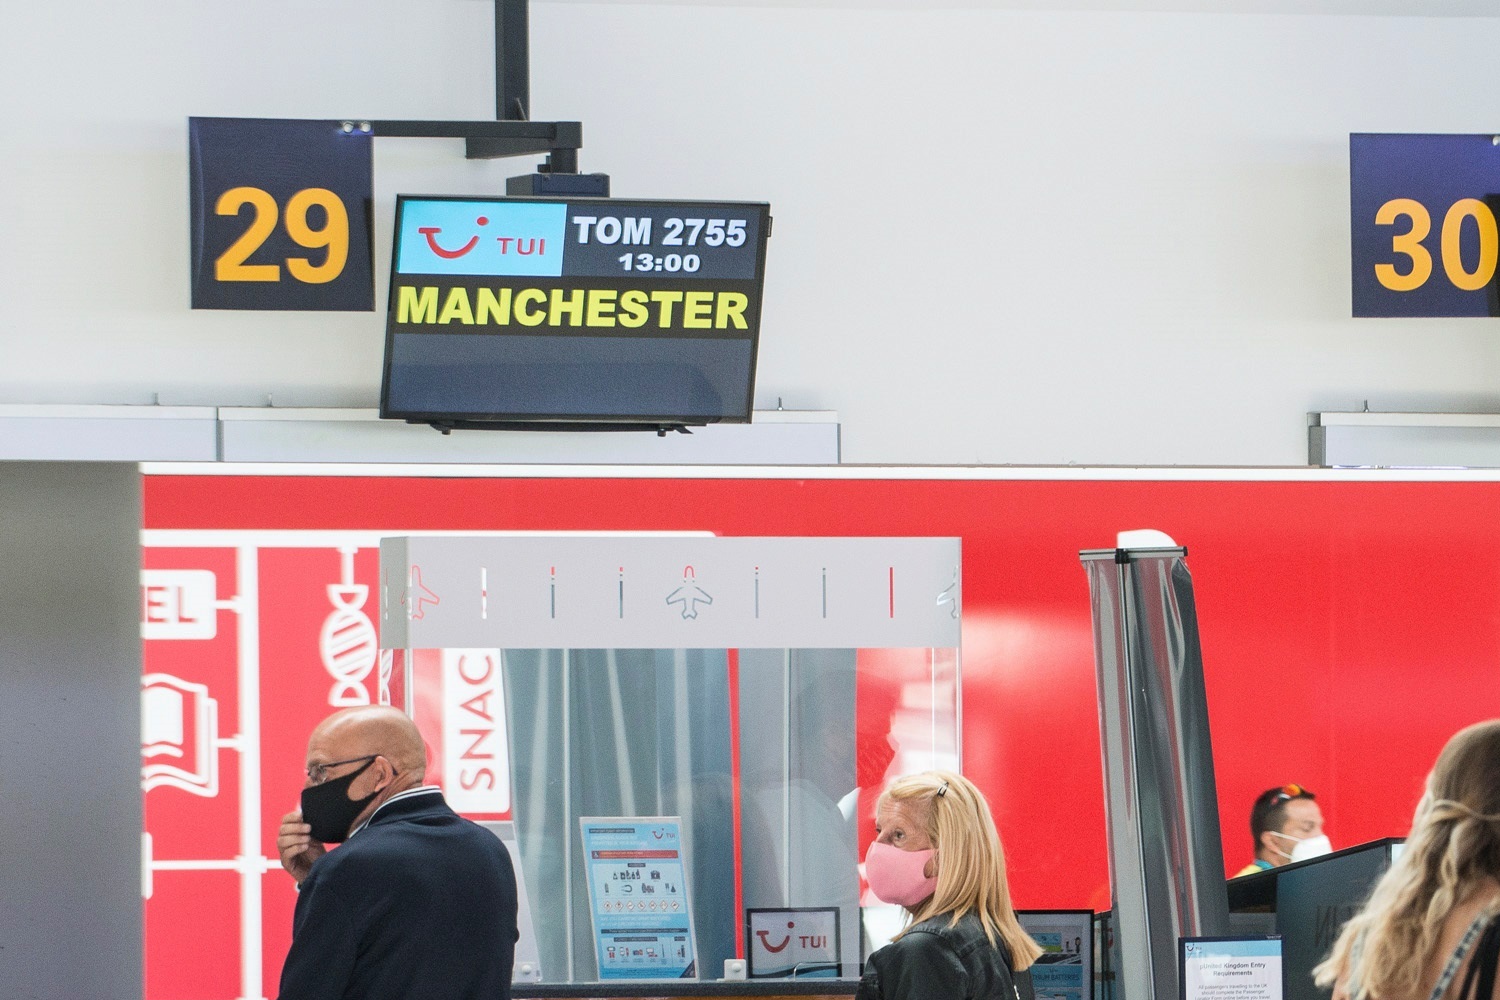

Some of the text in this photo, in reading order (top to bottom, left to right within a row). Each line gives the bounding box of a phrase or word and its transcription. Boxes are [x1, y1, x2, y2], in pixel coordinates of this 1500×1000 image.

[214, 187, 350, 284] 29
[496, 236, 546, 256] TUI
[573, 216, 747, 248] TOM 2755
[1373, 198, 1499, 292] 30
[618, 252, 701, 272] 13:00
[395, 286, 749, 330] MANCHESTER
[458, 654, 495, 791] SNAC
[798, 935, 828, 950] TUI
